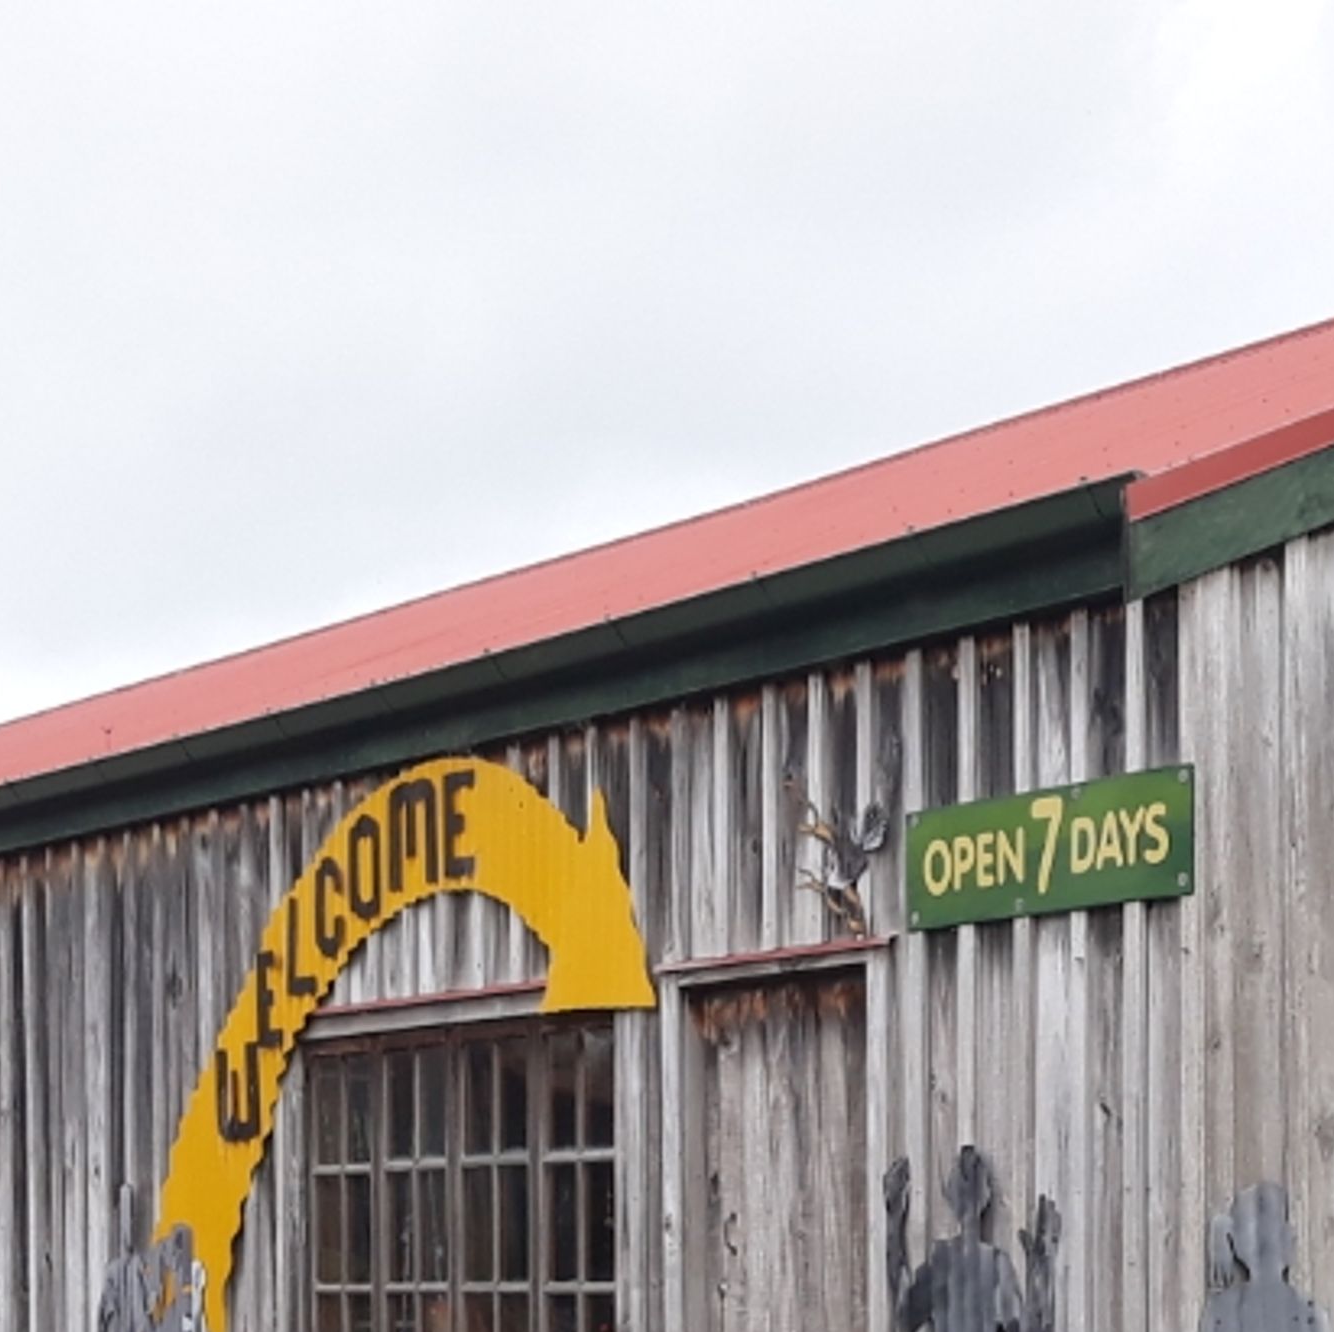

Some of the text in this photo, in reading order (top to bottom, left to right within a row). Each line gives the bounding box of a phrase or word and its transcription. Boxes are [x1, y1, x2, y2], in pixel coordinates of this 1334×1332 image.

[213, 768, 477, 1146] WELCOME
[923, 794, 1169, 896] OPEN 7 DAYS
